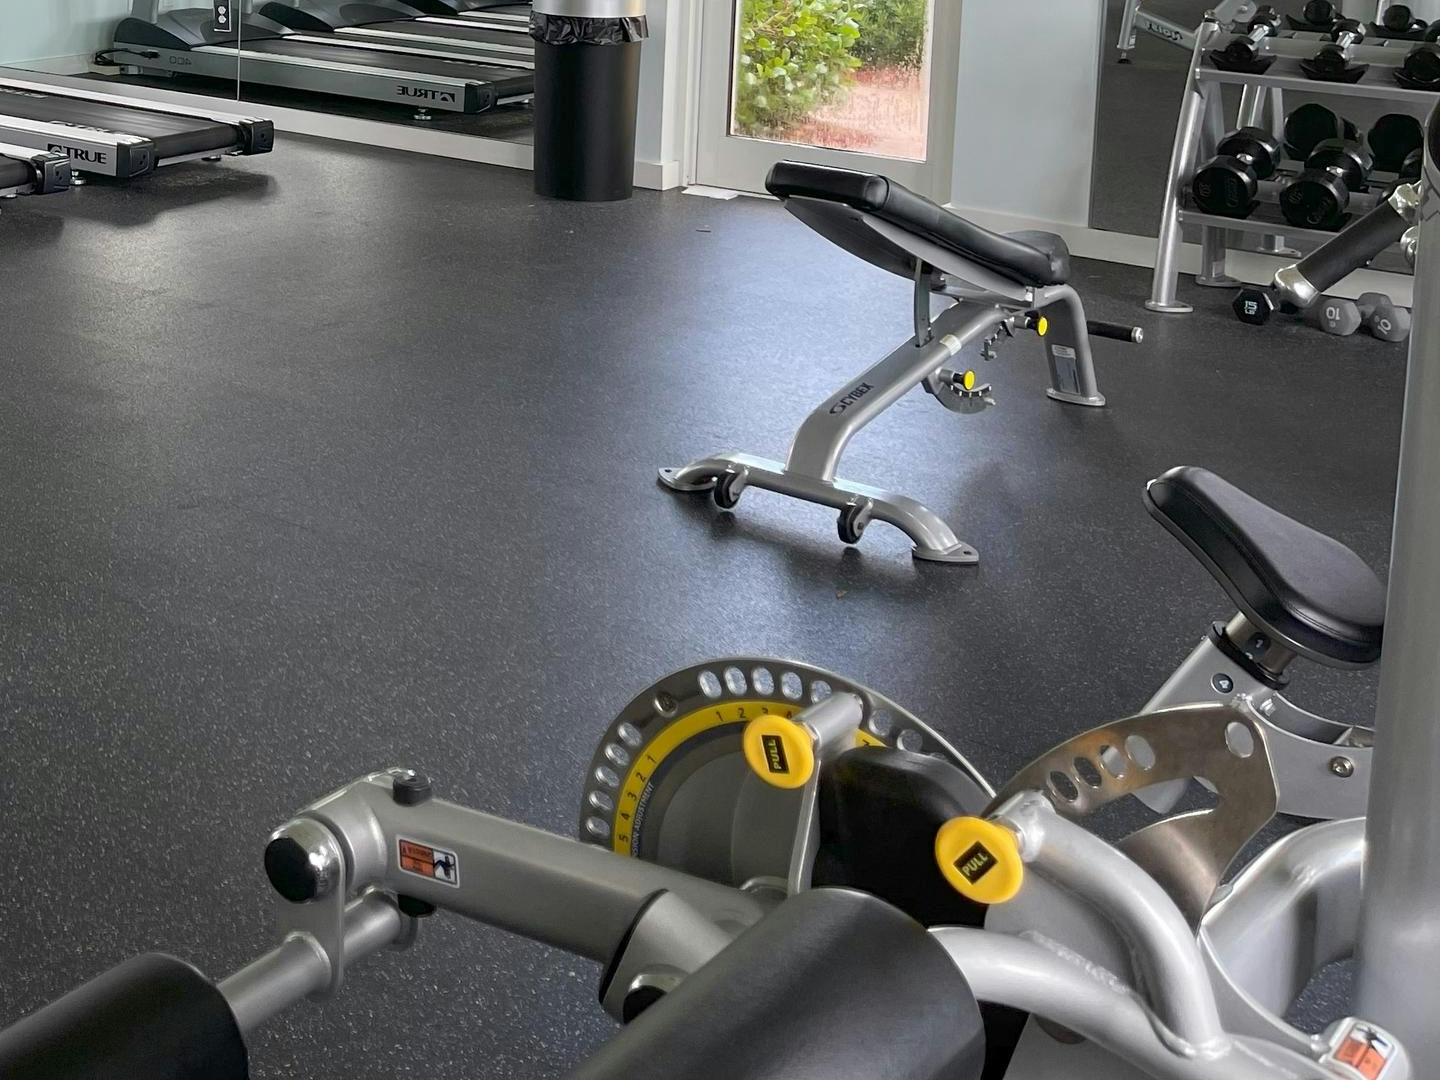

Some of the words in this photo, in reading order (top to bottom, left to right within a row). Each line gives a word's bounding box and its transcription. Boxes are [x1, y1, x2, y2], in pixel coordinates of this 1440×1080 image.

[63, 145, 107, 165] TRUE
[840, 382, 874, 406] CYBEX
[738, 707, 746, 719] 2
[768, 739, 782, 770] PULL
[636, 772, 646, 782] 2
[627, 791, 637, 801] 3
[634, 782, 654, 831] ADJUSTMENT
[621, 812, 630, 820] 4
[619, 834, 629, 843] 5
[962, 853, 988, 877] PULL
